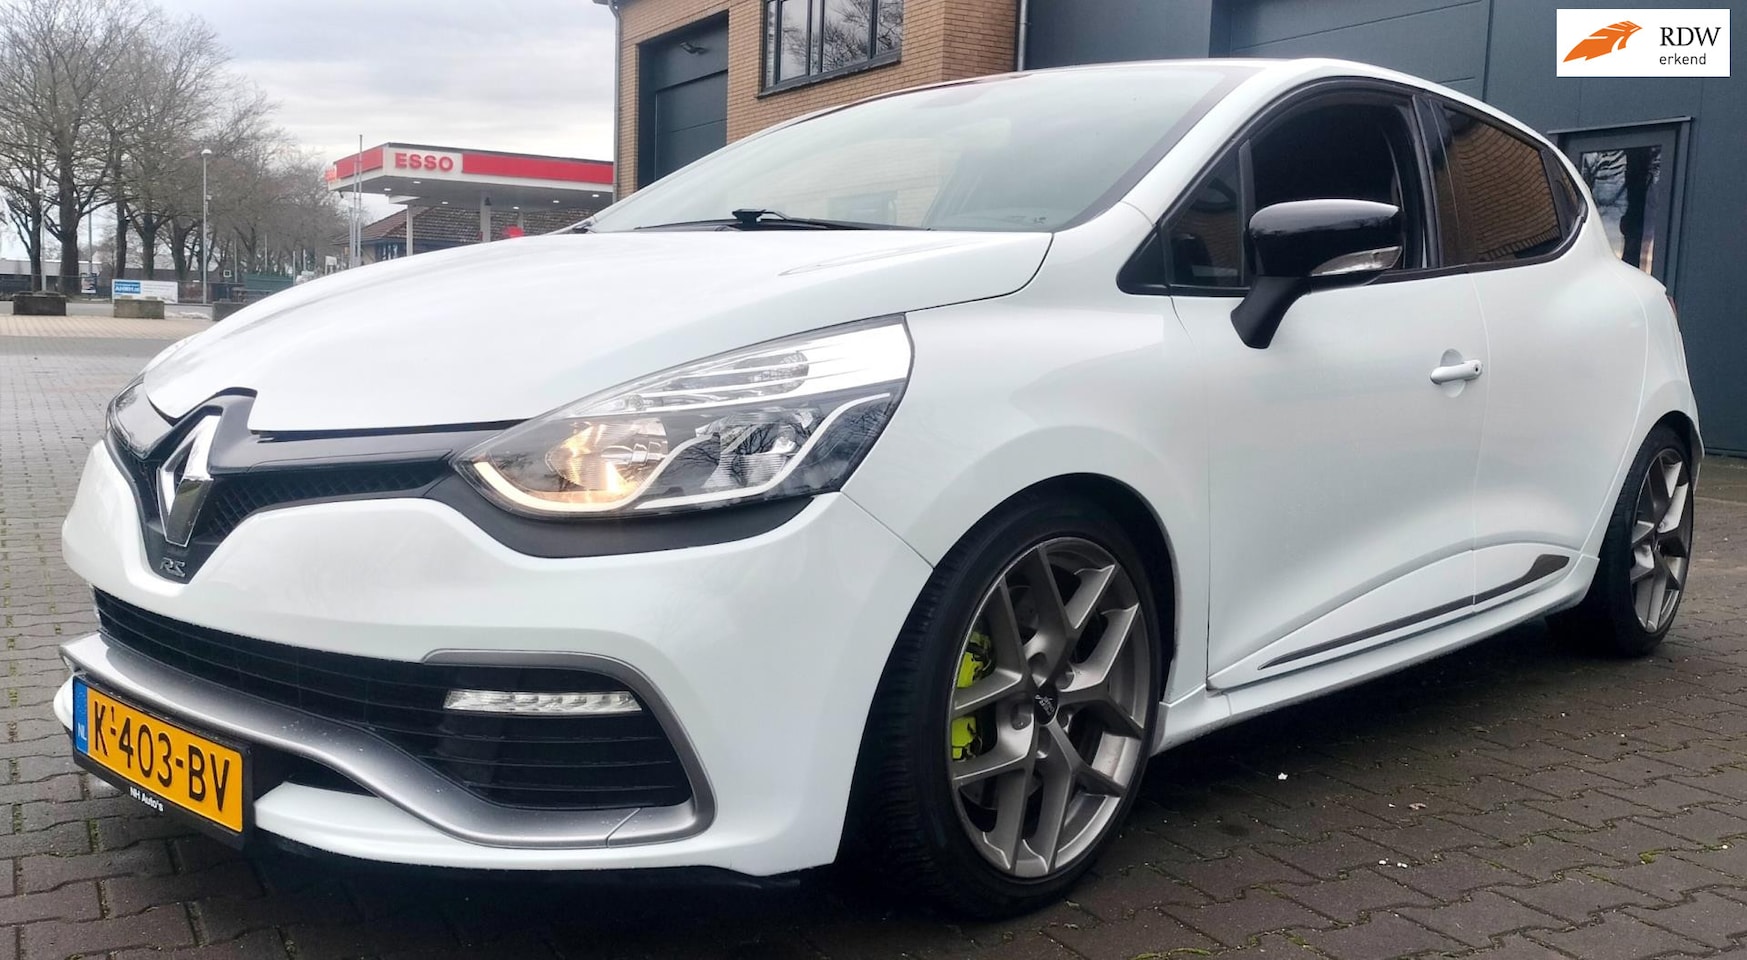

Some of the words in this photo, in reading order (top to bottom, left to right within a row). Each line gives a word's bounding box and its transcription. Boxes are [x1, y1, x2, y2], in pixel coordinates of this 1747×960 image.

[395, 152, 454, 172] ESSO
[77, 722, 88, 741] NL
[94, 701, 230, 812] K-403-BV
[130, 786, 141, 801] NH
[141, 792, 164, 812] Auto's
